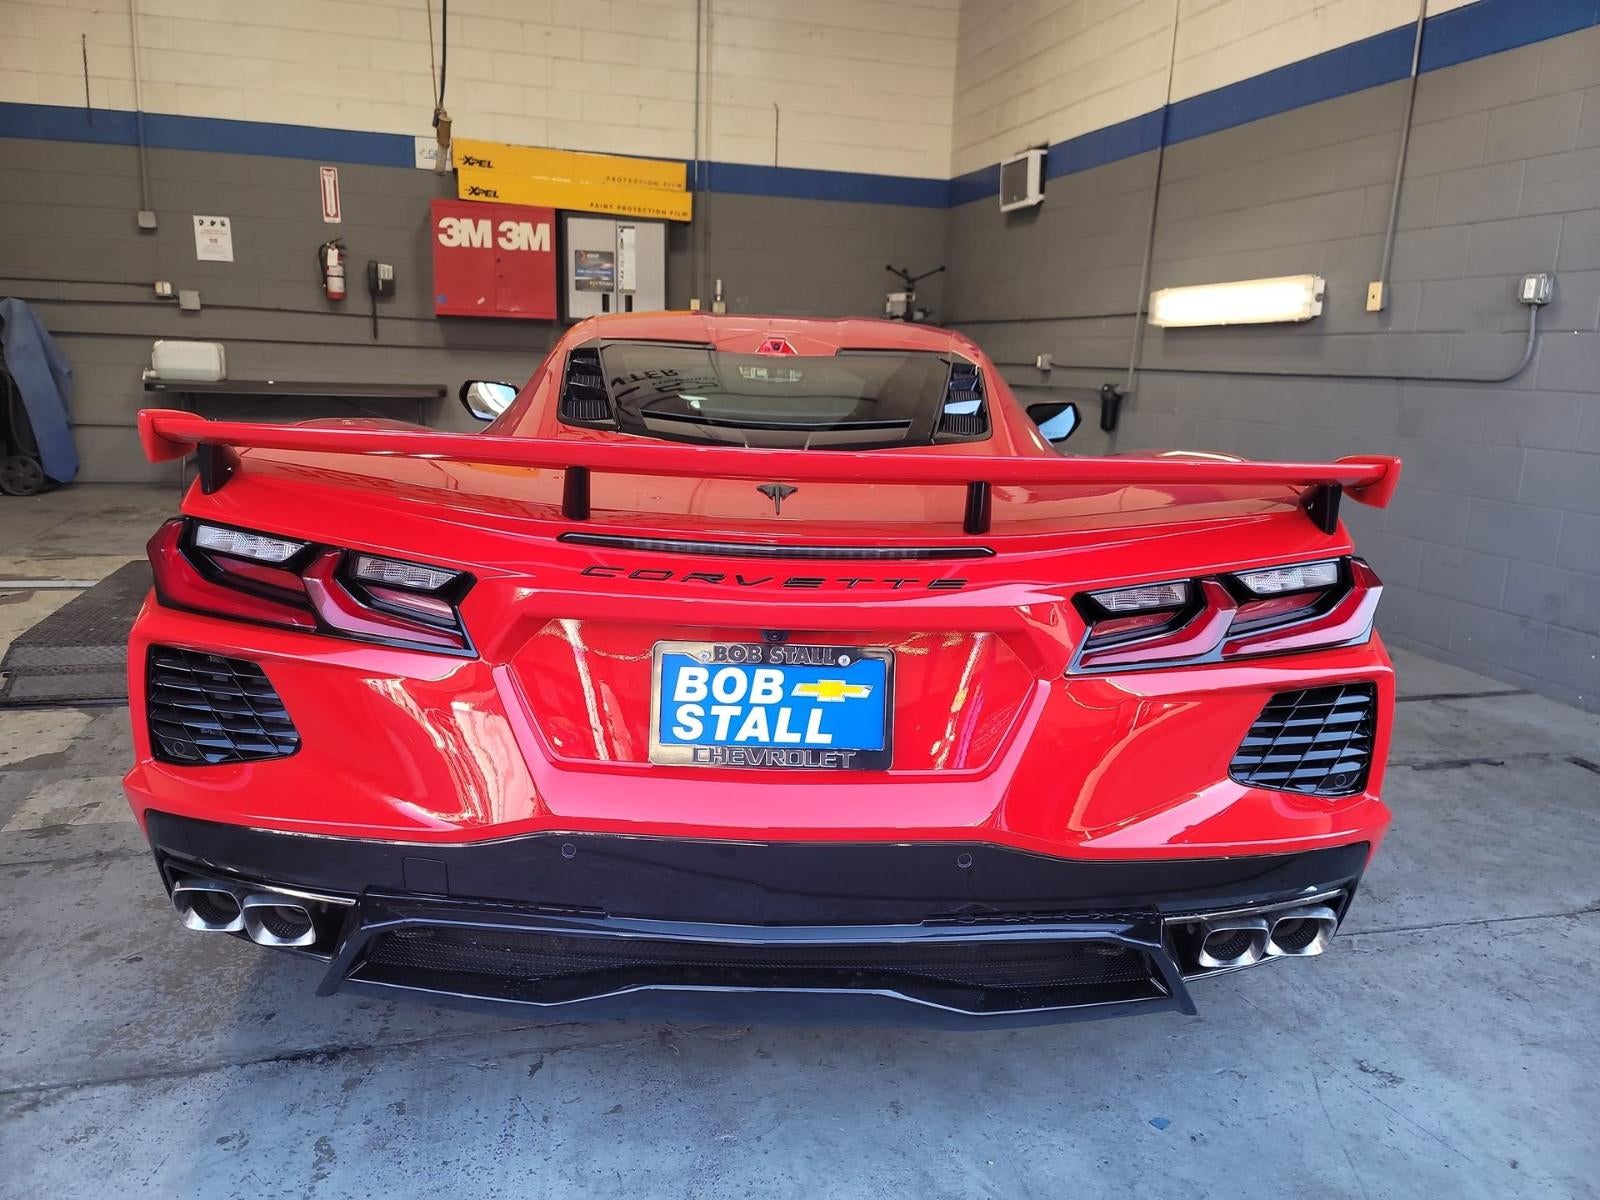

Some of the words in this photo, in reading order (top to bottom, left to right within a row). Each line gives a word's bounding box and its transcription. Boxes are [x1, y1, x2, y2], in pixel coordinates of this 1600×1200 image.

[461, 155, 494, 169] XPEL
[467, 185, 499, 199] XPEL
[606, 176, 659, 187] PROTECTION
[590, 202, 613, 210] PAINT
[617, 205, 667, 216] PROTECTION
[670, 210, 688, 218] FILM
[438, 217, 493, 249] 3M
[497, 221, 551, 252] 3M
[580, 564, 969, 590] CORVETTE
[713, 645, 763, 664] BOB
[770, 646, 836, 666] STALL
[673, 666, 785, 705] BOB
[672, 704, 833, 744] STALL
[692, 747, 857, 768] CHEVROLET
